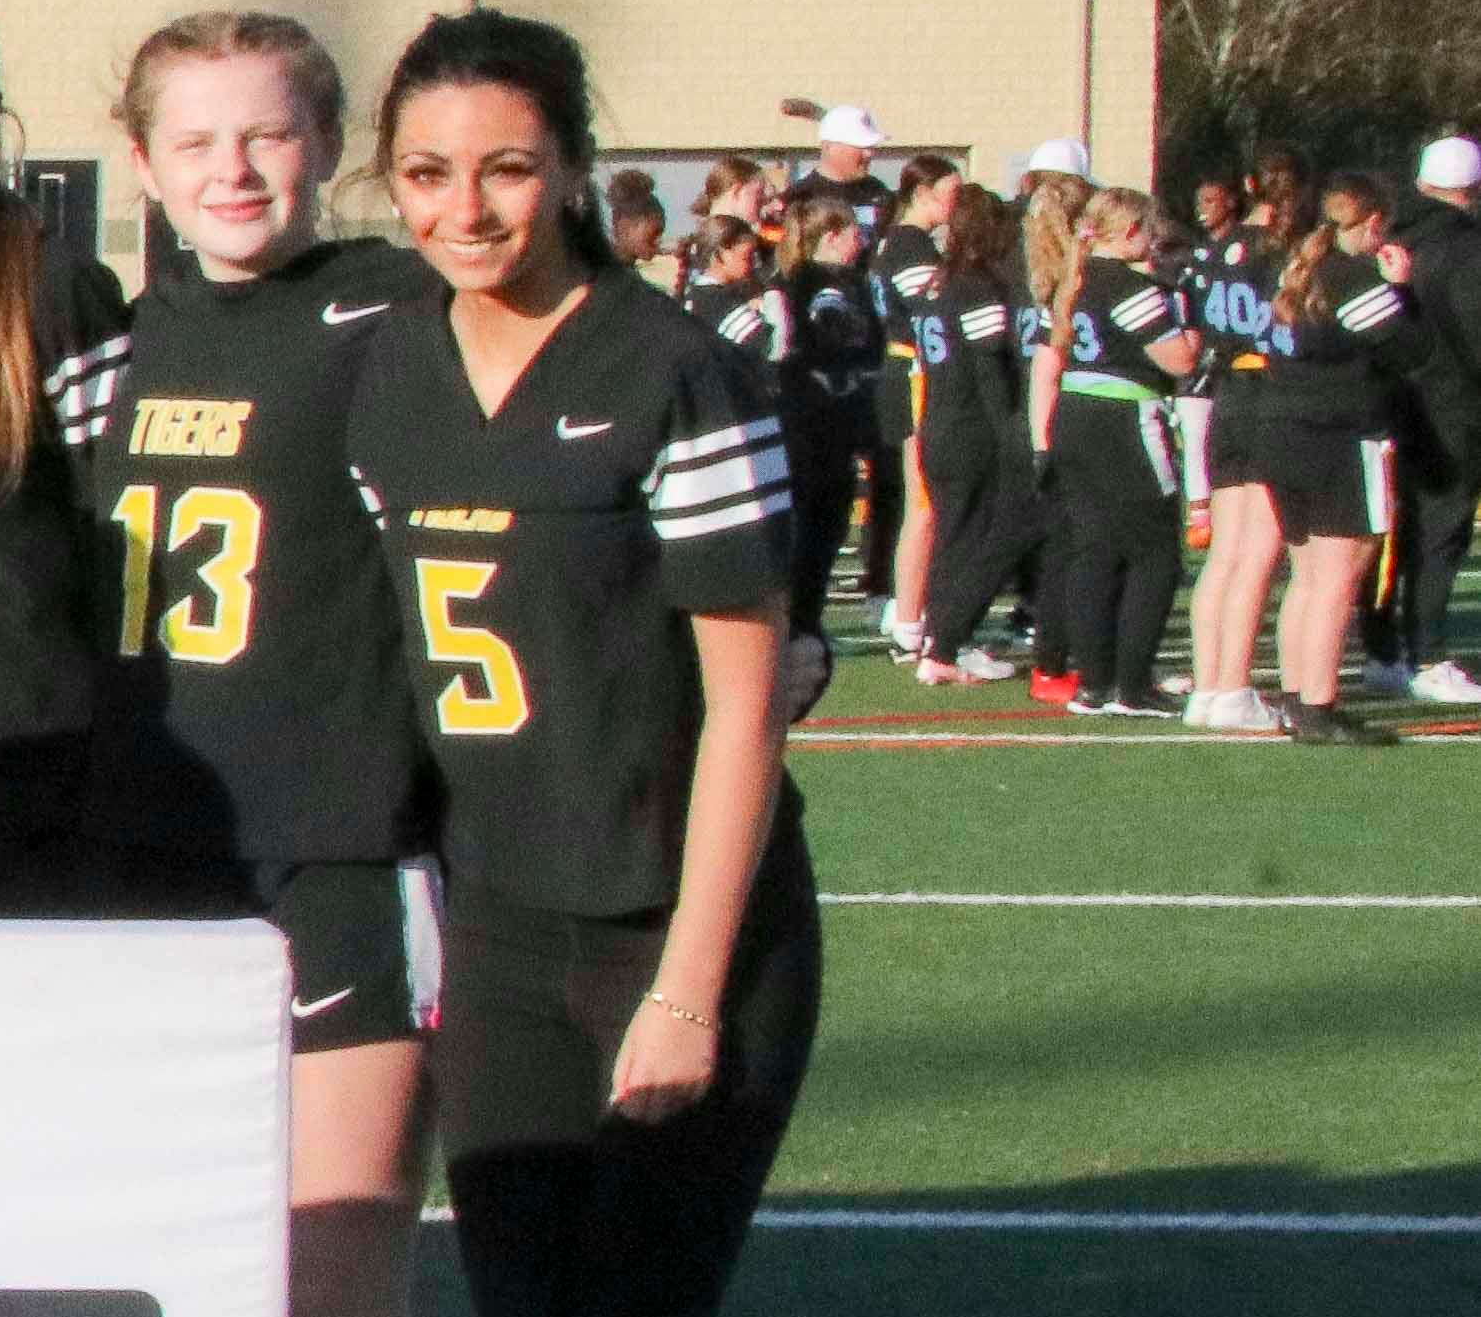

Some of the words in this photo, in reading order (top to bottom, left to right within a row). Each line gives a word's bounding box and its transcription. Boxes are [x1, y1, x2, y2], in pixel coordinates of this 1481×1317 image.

[128, 398, 255, 457] TIGERS
[110, 485, 262, 665] 13
[415, 558, 529, 735] 5
